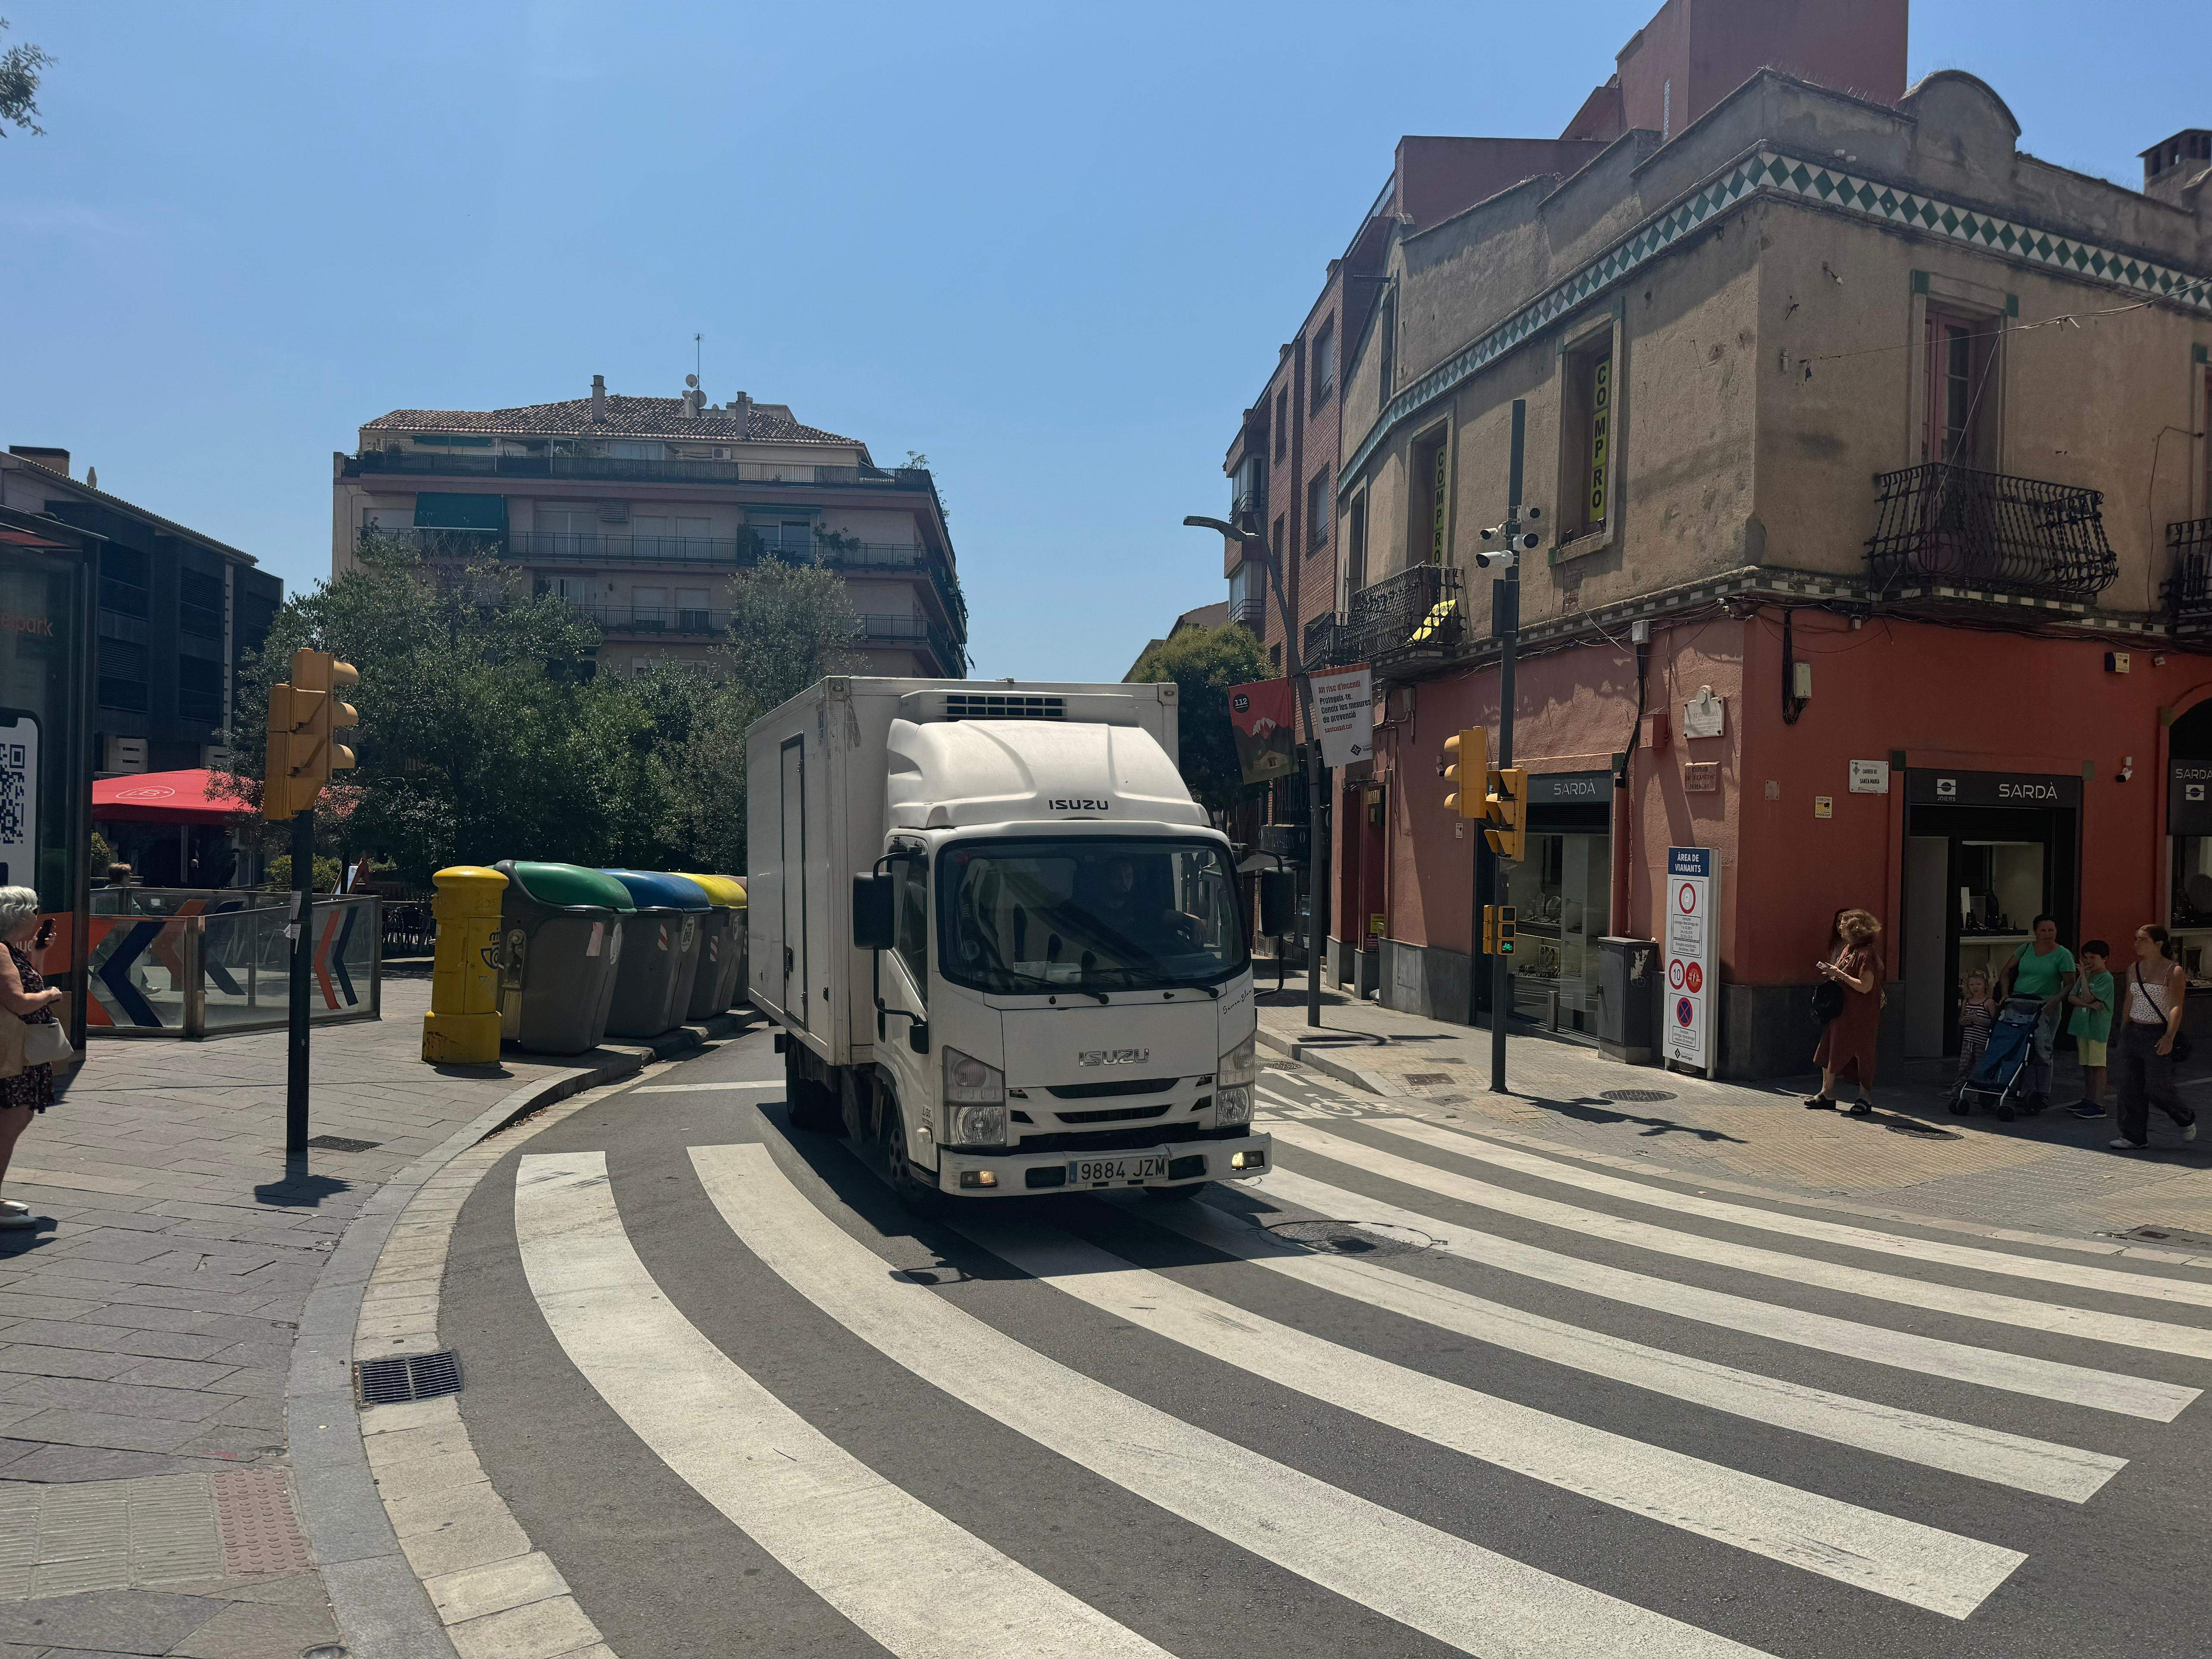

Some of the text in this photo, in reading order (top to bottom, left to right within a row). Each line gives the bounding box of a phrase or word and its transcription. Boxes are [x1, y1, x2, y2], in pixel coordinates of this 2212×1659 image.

[1592, 365, 1606, 508] COMPRO
[1433, 452, 1444, 563] COMPRO
[1326, 685, 1336, 693] risc
[1338, 680, 1360, 691] d'incendi
[1349, 699, 1371, 709] mesures
[1554, 778, 1595, 795] SARDÀ
[1999, 782, 2057, 799] SARDÀ
[1049, 800, 1109, 810] ISUZU
[1677, 852, 1691, 861] ÀREA
[1675, 864, 1701, 873] VIANANTS
[1673, 969, 1681, 980] 10
[1079, 1049, 1149, 1066] ISUZU
[1081, 1158, 1165, 1180] 9884 JZM
